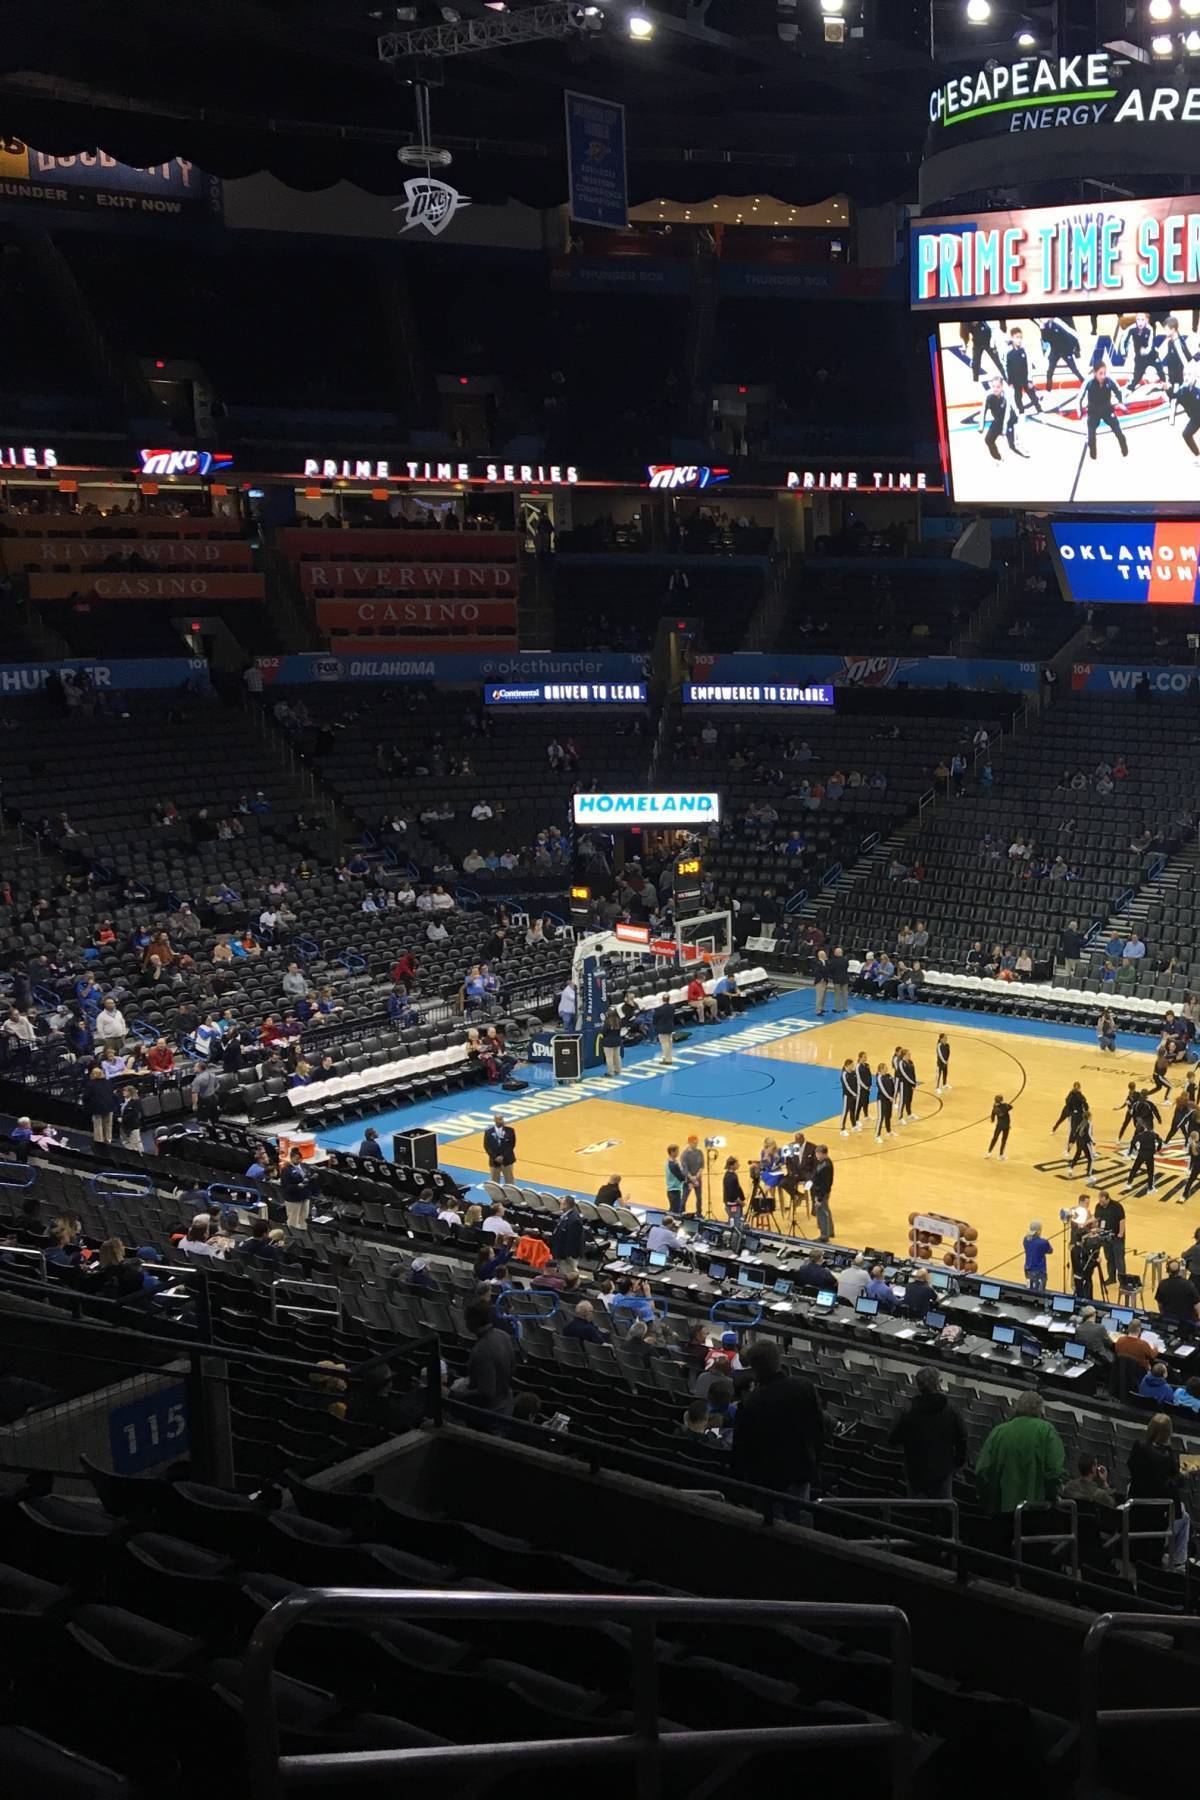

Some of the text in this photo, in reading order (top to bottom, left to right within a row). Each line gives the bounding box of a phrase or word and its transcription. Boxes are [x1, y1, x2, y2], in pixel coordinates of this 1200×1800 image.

[929, 53, 1109, 122] CHESAPEAKE
[1009, 103, 1108, 133] ENERGY
[96, 193, 136, 209] EXIT
[141, 199, 182, 214] NOW
[918, 229, 1025, 298] PRIME
[1040, 219, 1123, 291] TIME
[303, 459, 579, 483] PRIME TIME SERIES
[787, 471, 927, 489] PRIME TIME
[41, 544, 221, 561] RIVERWIND
[310, 568, 512, 586] RIVERWIND
[95, 578, 208, 595] CASINO
[358, 603, 479, 621] CASINO
[188, 659, 208, 669] 101
[257, 657, 280, 668] 102
[695, 655, 714, 665] 103
[317, 661, 436, 676] FOX OKLAHOMA
[480, 660, 602, 677] @okcthunder
[1019, 663, 1036, 673] 103
[1073, 665, 1090, 674] 104
[498, 689, 539, 698] Continental
[592, 685, 607, 700] TO
[691, 686, 759, 701] EMPOWERED
[763, 686, 776, 701] TO
[579, 796, 712, 812] HOMELAND
[364, 1161, 375, 1173] G
[379, 1164, 391, 1176] G
[396, 1169, 406, 1181] G
[413, 1173, 425, 1185] G
[433, 1174, 444, 1186] G
[123, 1403, 185, 1455] 115
